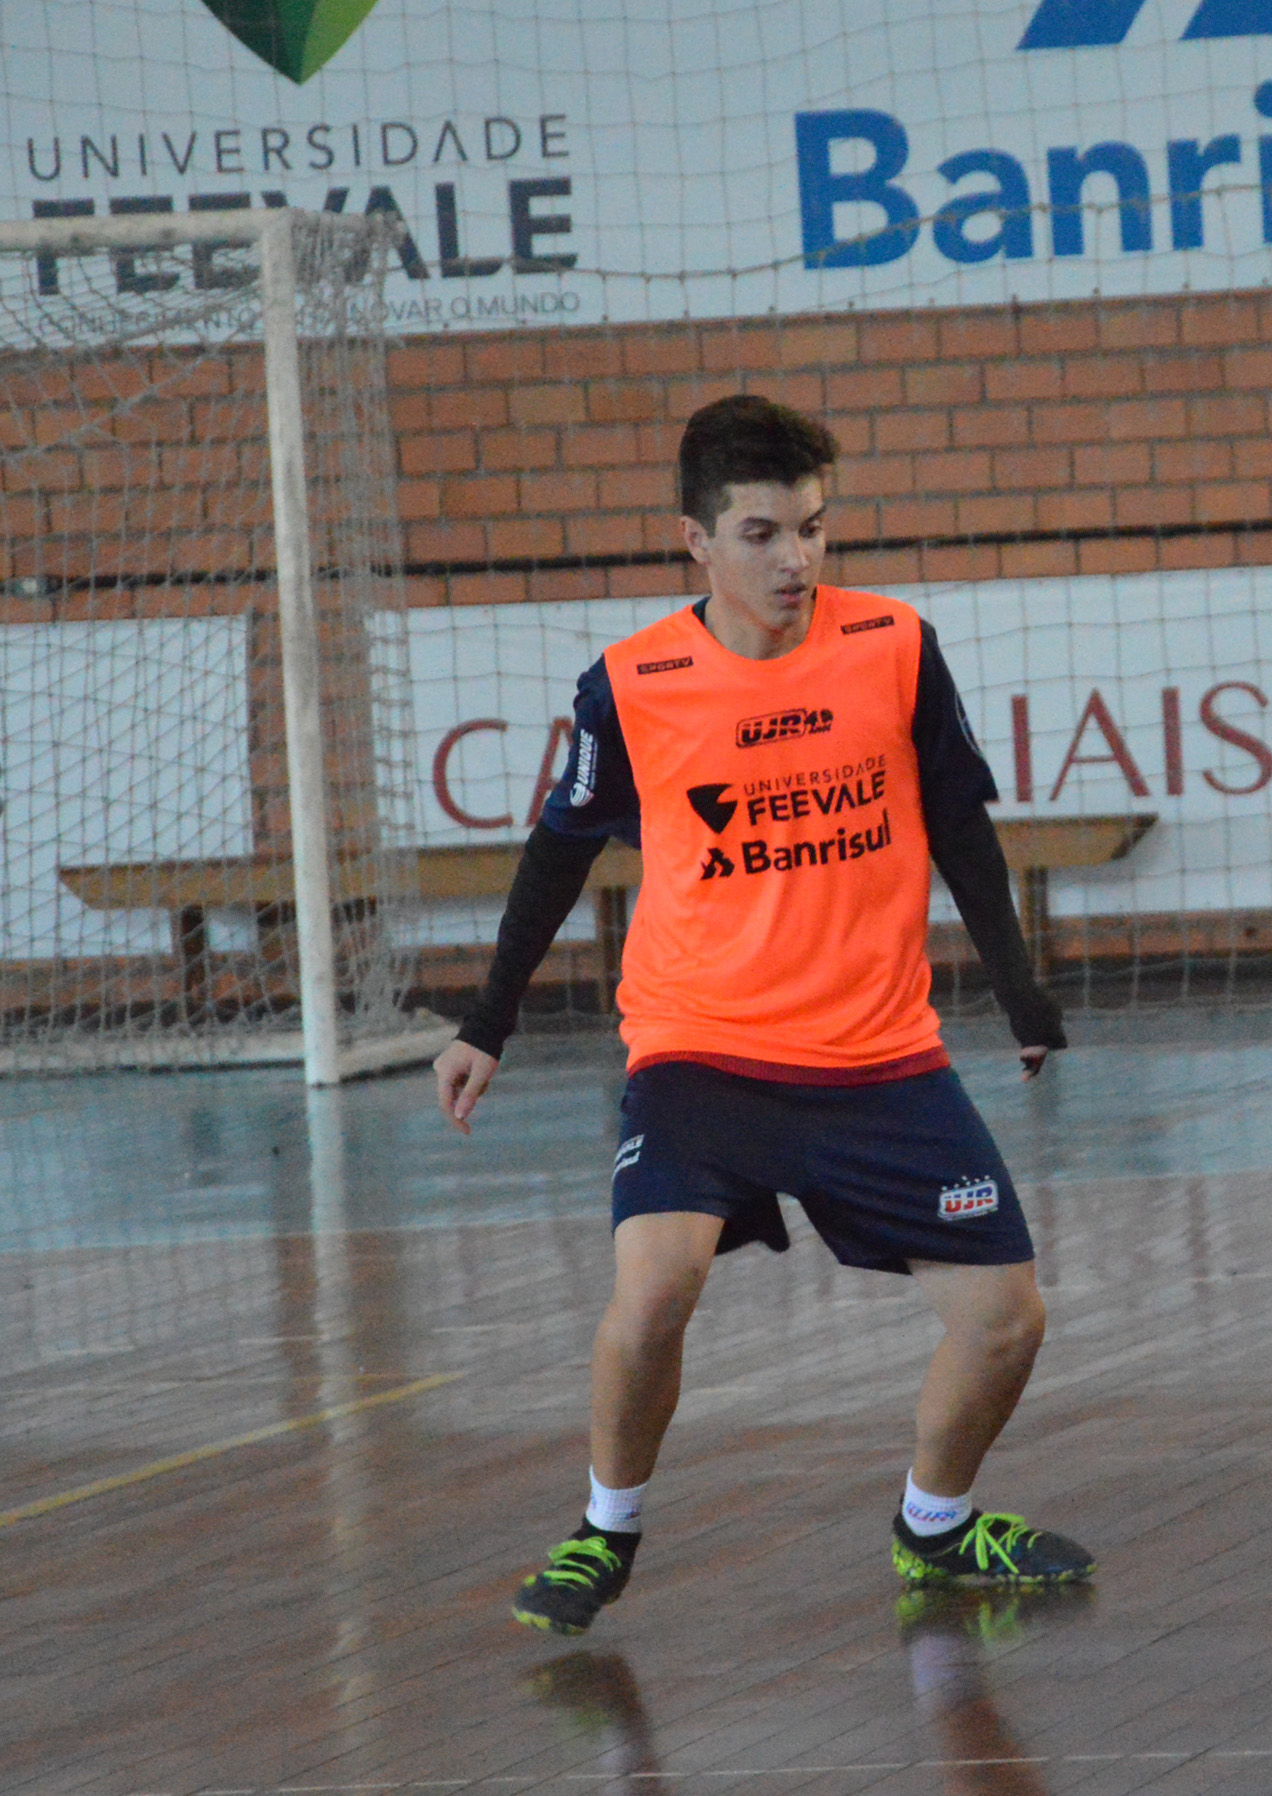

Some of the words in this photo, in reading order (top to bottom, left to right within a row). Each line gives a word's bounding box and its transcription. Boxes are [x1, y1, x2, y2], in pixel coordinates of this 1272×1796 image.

[26, 113, 571, 181] UNIVERSIDADE
[451, 297, 473, 320] O
[477, 290, 581, 317] MUNDO
[577, 728, 594, 786] UNIQUE
[743, 753, 887, 797] UNIVERSIDADE
[747, 770, 886, 827] FEEVALE
[741, 807, 892, 875] Banrisul
[944, 1186, 994, 1213] UJR
